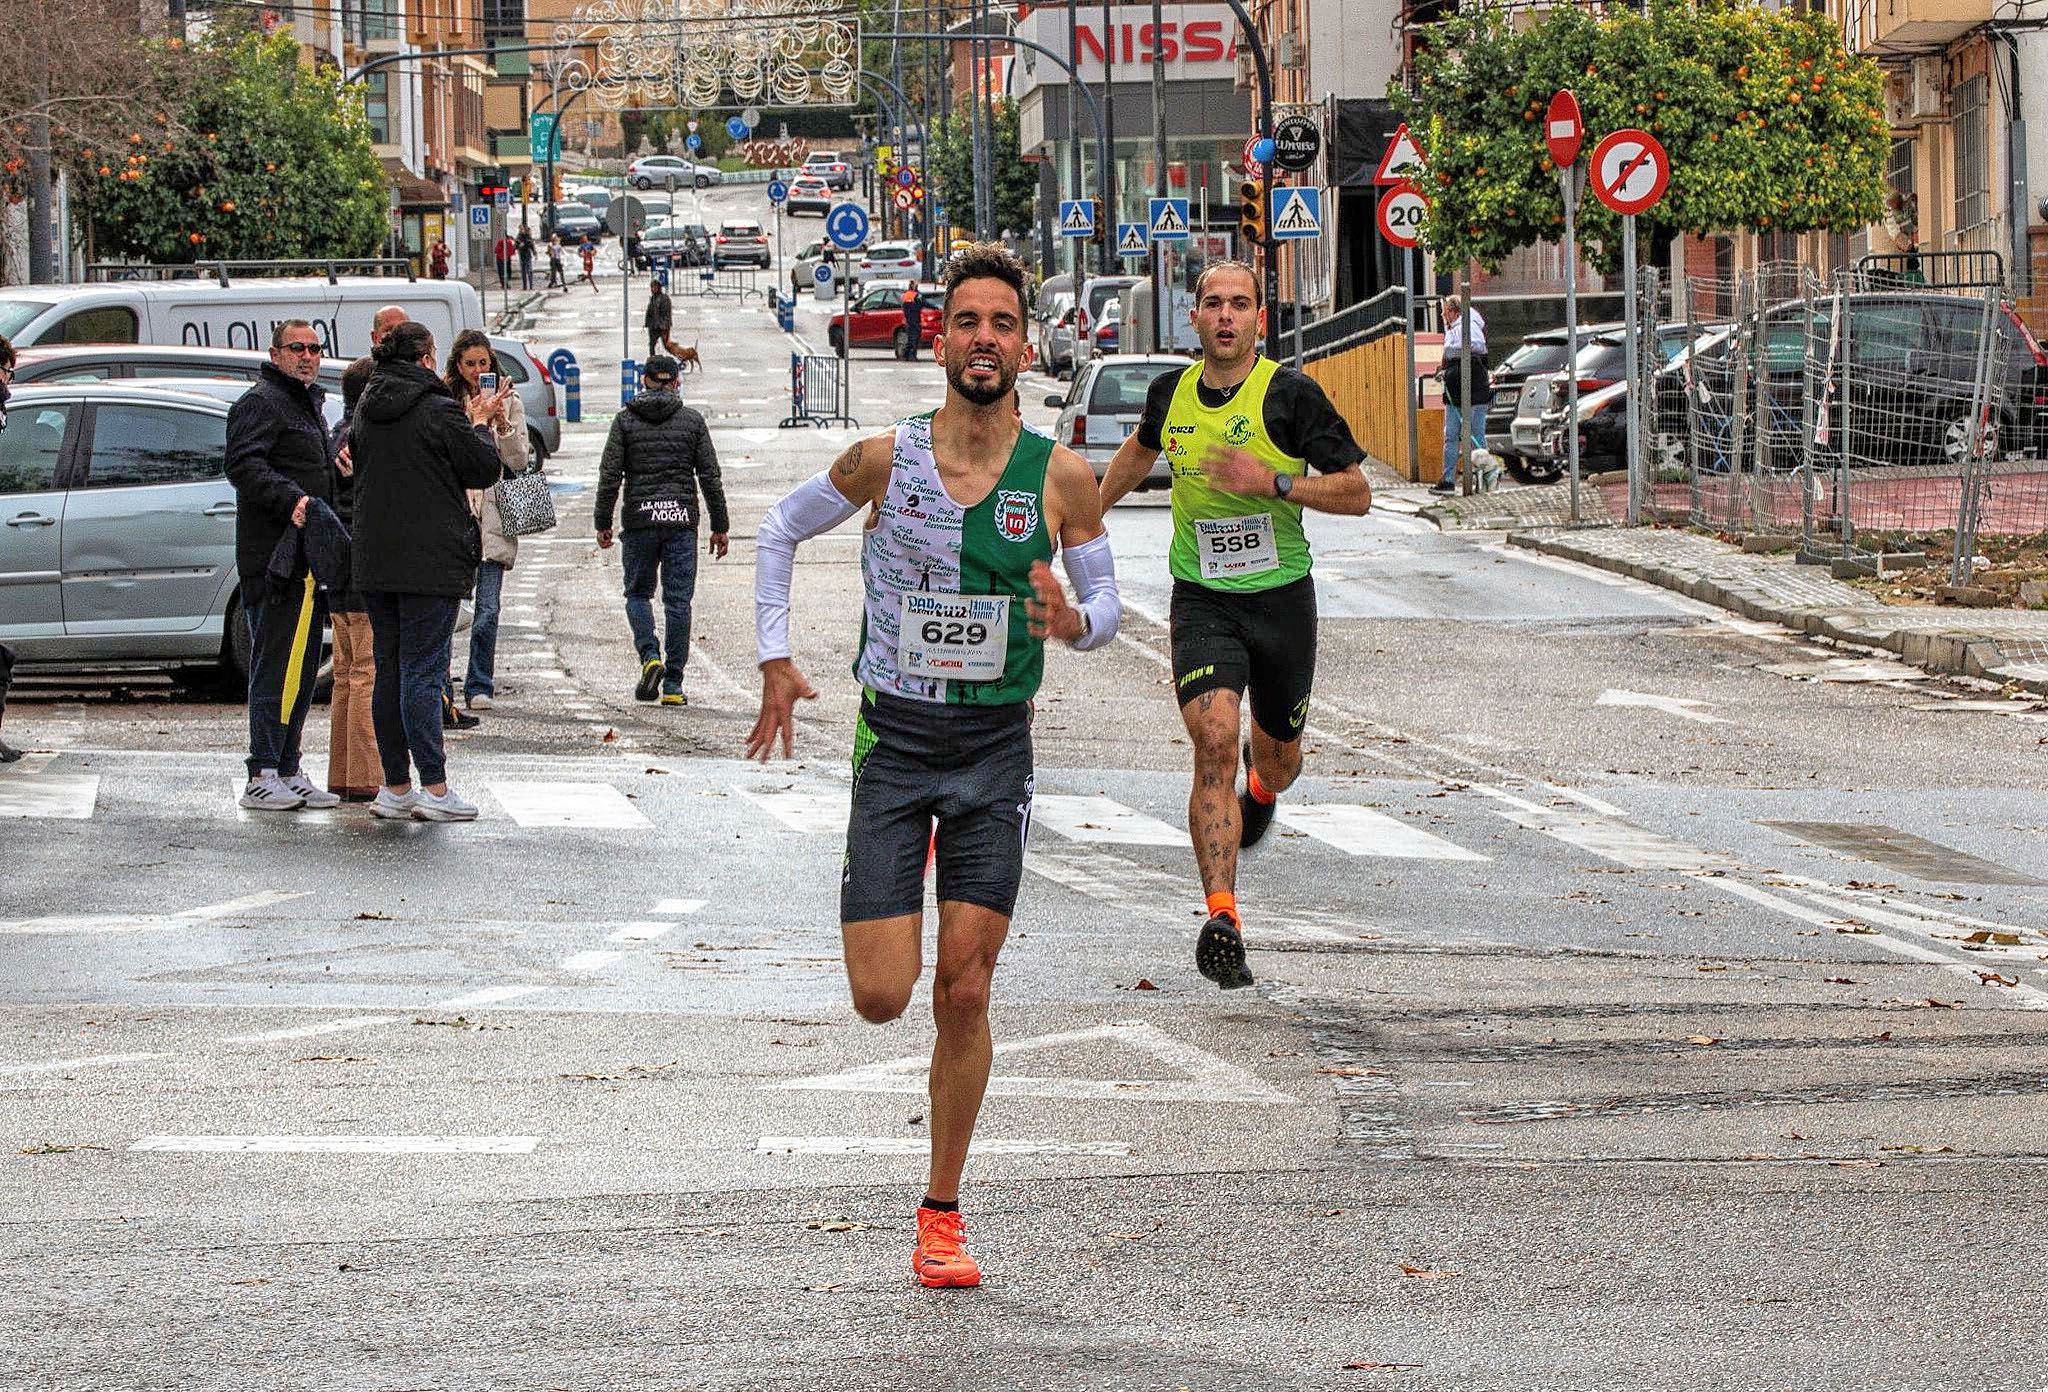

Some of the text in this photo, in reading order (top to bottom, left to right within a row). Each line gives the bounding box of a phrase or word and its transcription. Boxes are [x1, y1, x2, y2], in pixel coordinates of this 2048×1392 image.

[1075, 21, 1236, 65] NISS
[1391, 206, 1422, 226] 20
[1211, 533, 1260, 553] 558
[921, 621, 987, 645] 629
